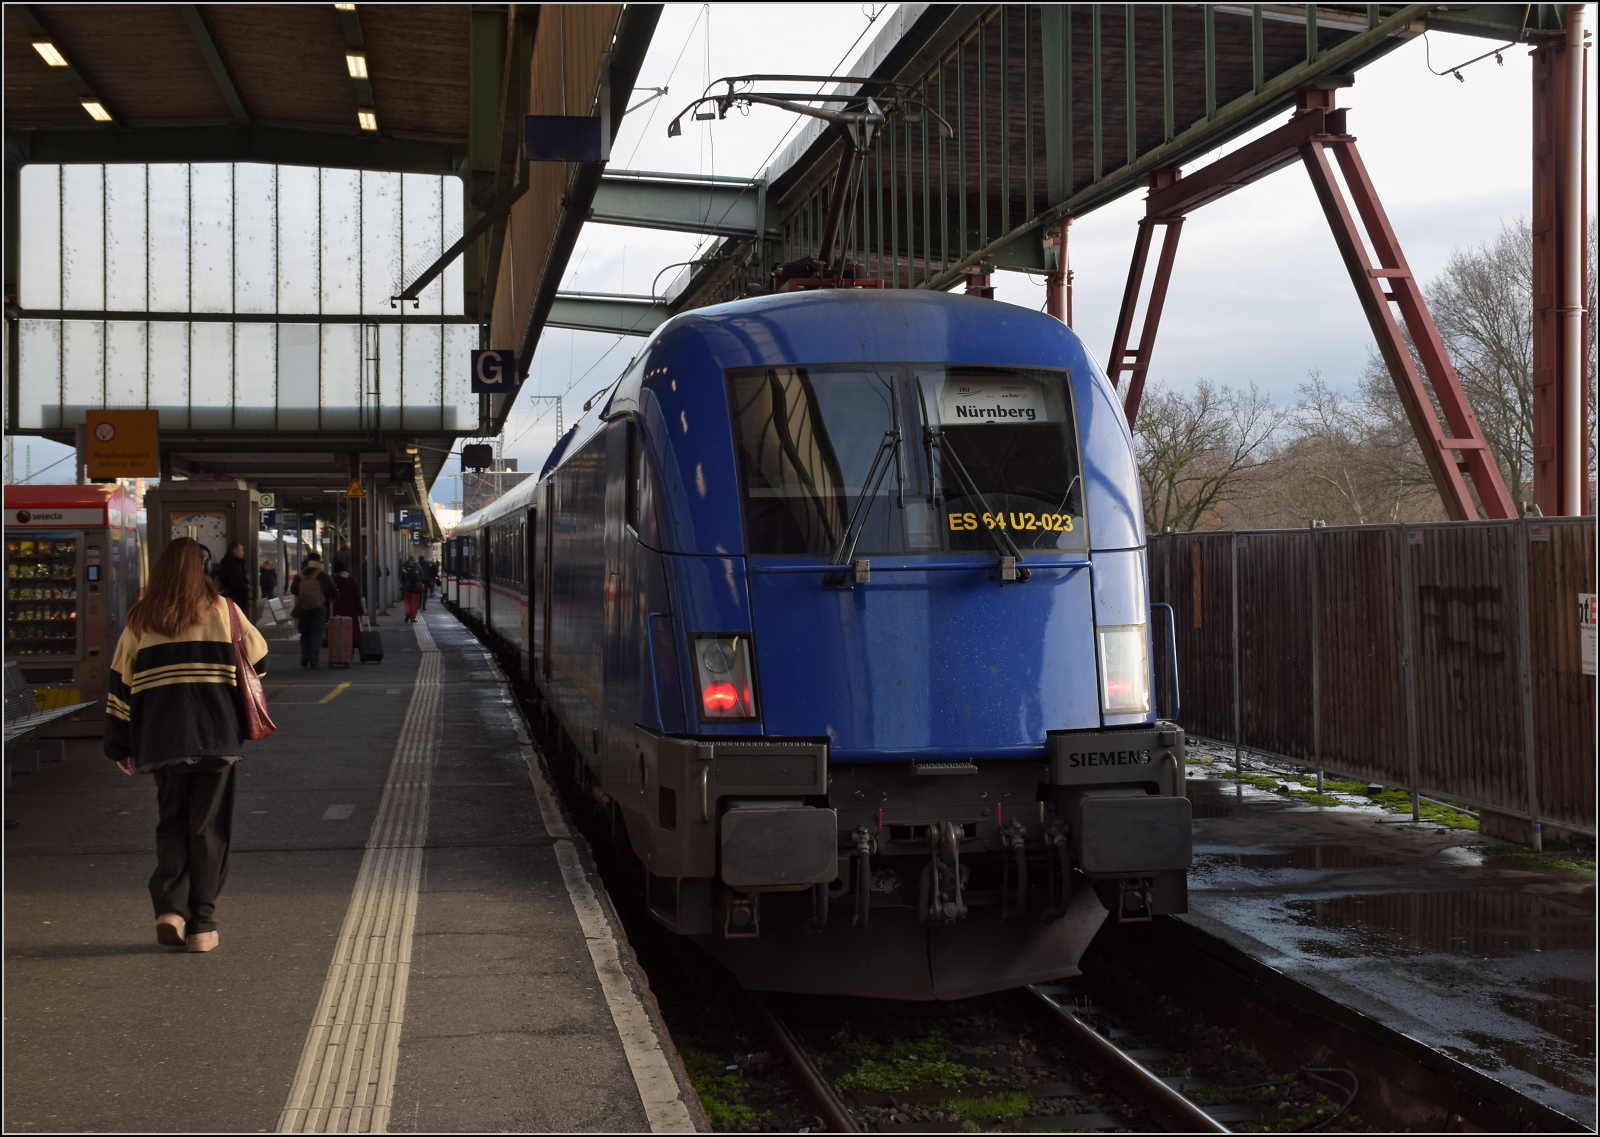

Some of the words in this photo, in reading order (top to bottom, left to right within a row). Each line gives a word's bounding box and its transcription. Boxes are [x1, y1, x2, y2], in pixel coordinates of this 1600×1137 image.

[477, 351, 502, 384] G
[956, 405, 1036, 421] Nürnberg
[32, 512, 63, 520] selecta
[260, 511, 269, 523] F
[399, 509, 409, 523] F
[948, 513, 978, 531] ES
[982, 513, 1007, 531] 64
[1009, 513, 1074, 532] U2-023
[413, 531, 420, 540] E
[1069, 749, 1152, 768] SIEMENS
